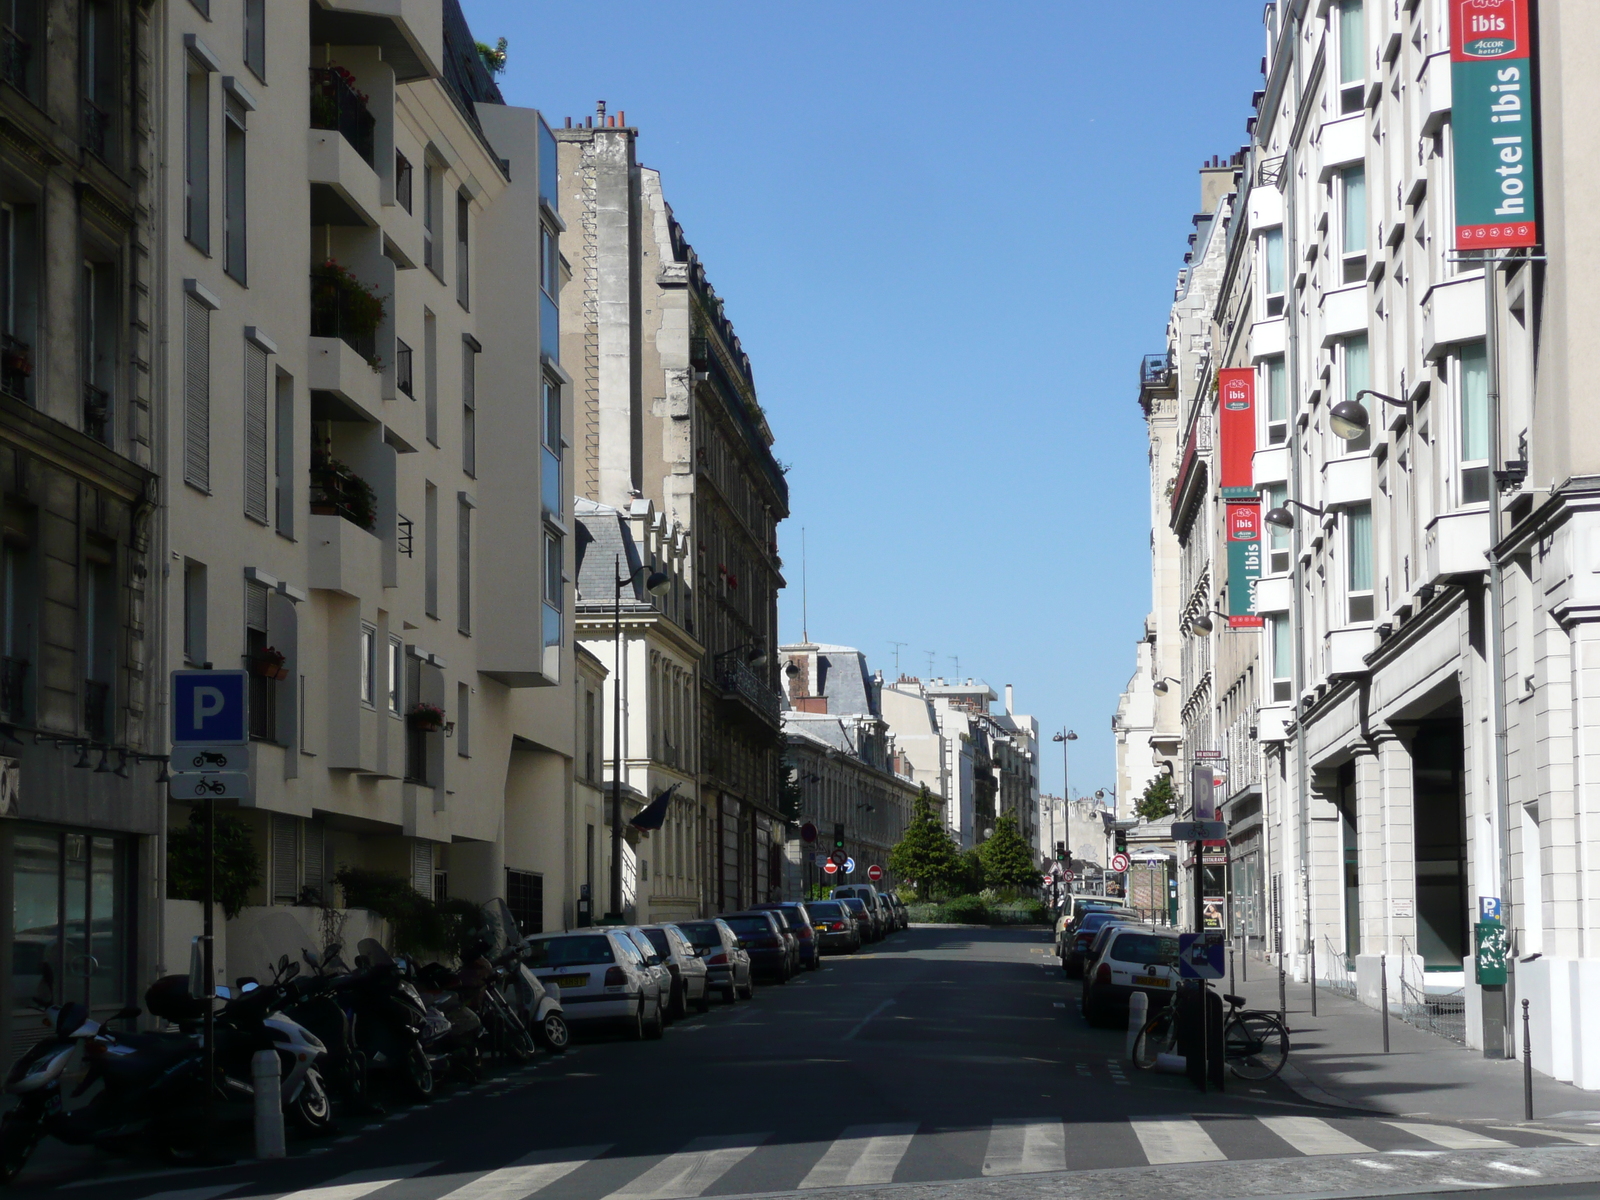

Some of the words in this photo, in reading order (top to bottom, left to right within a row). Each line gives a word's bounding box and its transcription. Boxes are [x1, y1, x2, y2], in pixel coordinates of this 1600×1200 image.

[1472, 14, 1505, 32] ibis
[1490, 66, 1521, 123] ibis
[1492, 136, 1524, 215] hotel
[1229, 390, 1245, 399] ibis
[1236, 519, 1252, 528] ibis
[1245, 543, 1259, 570] ibis
[193, 686, 225, 730] P
[1200, 778, 1209, 810] P
[1483, 898, 1496, 914] P
